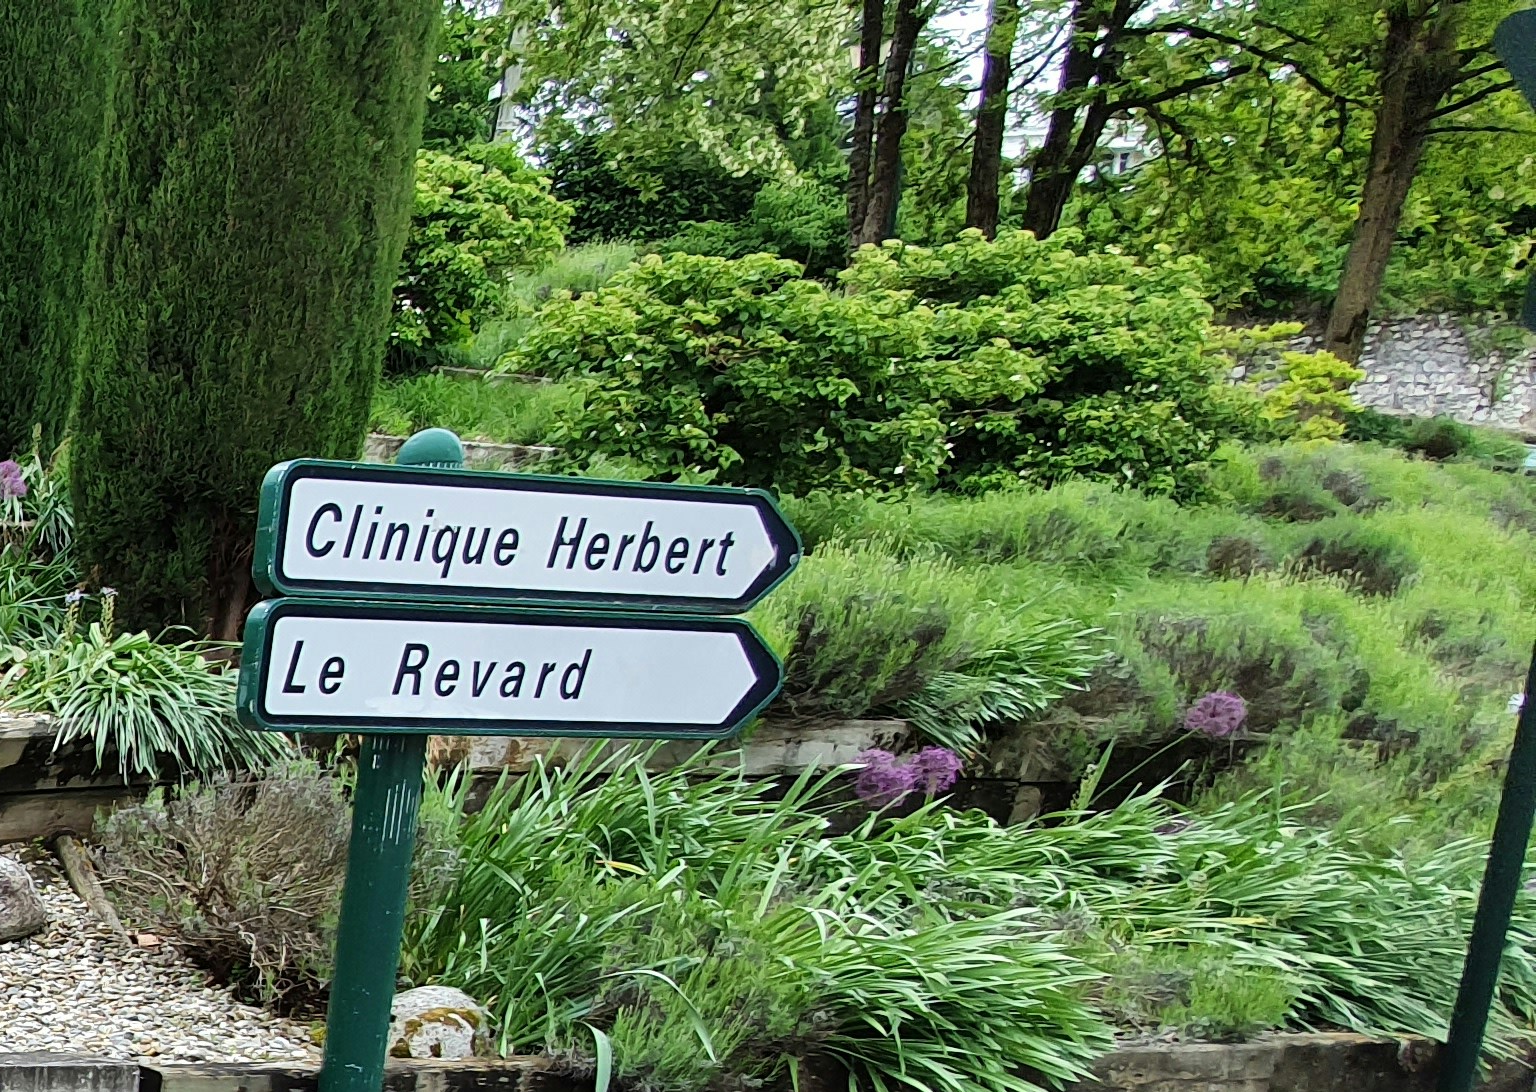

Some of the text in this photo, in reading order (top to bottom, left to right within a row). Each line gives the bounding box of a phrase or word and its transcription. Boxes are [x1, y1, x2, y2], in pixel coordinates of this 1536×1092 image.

[305, 503, 736, 579] Clinique Herbert
[281, 640, 593, 700] Le Revard
